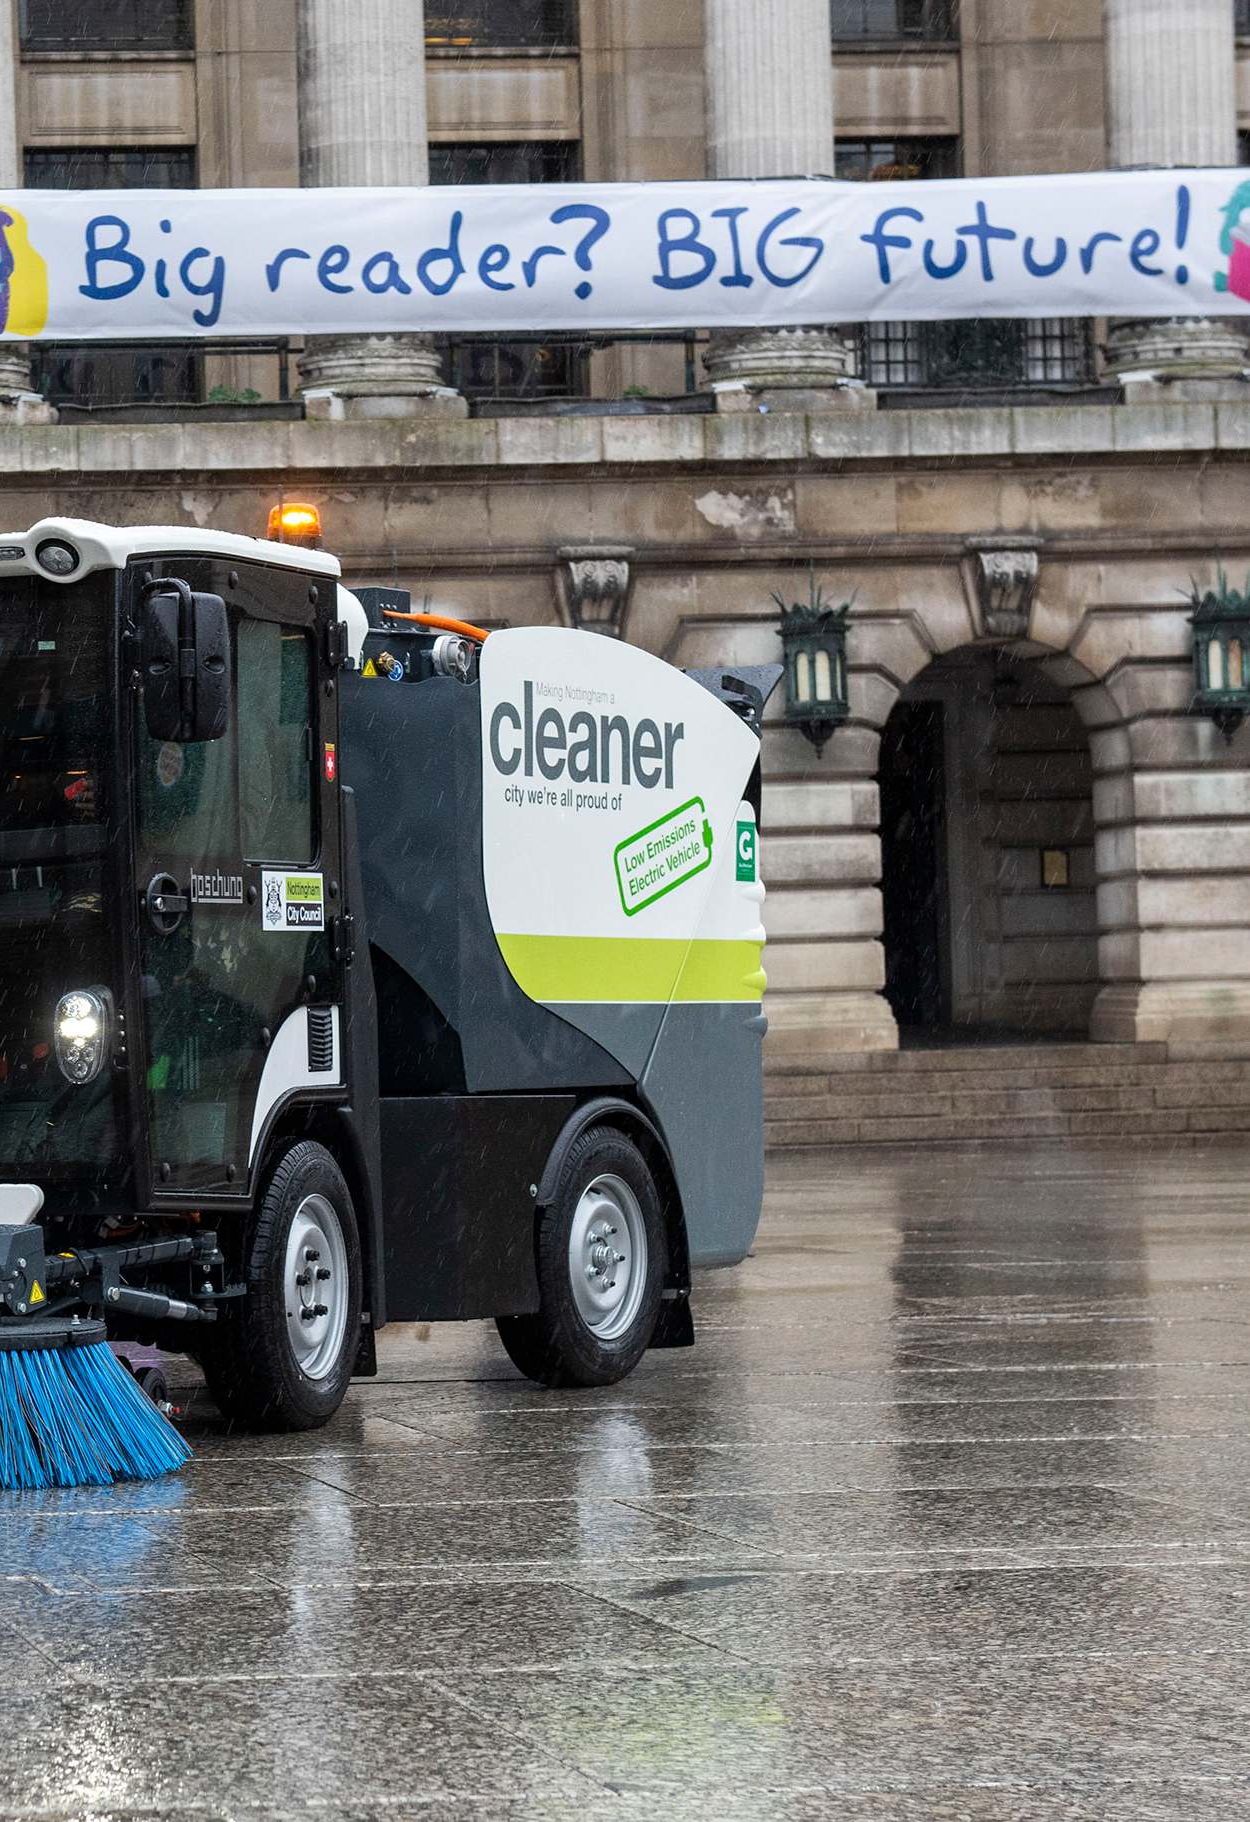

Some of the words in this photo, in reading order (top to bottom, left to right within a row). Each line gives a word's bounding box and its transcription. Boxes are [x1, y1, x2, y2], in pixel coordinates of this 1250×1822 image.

[78, 214, 225, 328] Big
[266, 203, 611, 300] reader?
[652, 206, 824, 291] BIG
[860, 184, 1190, 285] future!
[536, 682, 563, 702] Making
[565, 684, 609, 706] Nottingham
[609, 693, 615, 704] a
[489, 680, 684, 789] cleaner
[504, 785, 525, 807] city
[527, 786, 558, 806] we're
[560, 788, 573, 808] all
[576, 790, 608, 812] proud
[611, 793, 623, 811] of
[624, 851, 646, 874] Low
[645, 818, 696, 860] Emissions
[739, 831, 753, 861] G
[628, 857, 666, 897] Electric
[666, 839, 701, 874] Vehicle
[190, 867, 243, 904] boschung
[287, 882, 320, 898] Nottingham
[287, 906, 300, 924] City
[299, 906, 322, 921] Council
